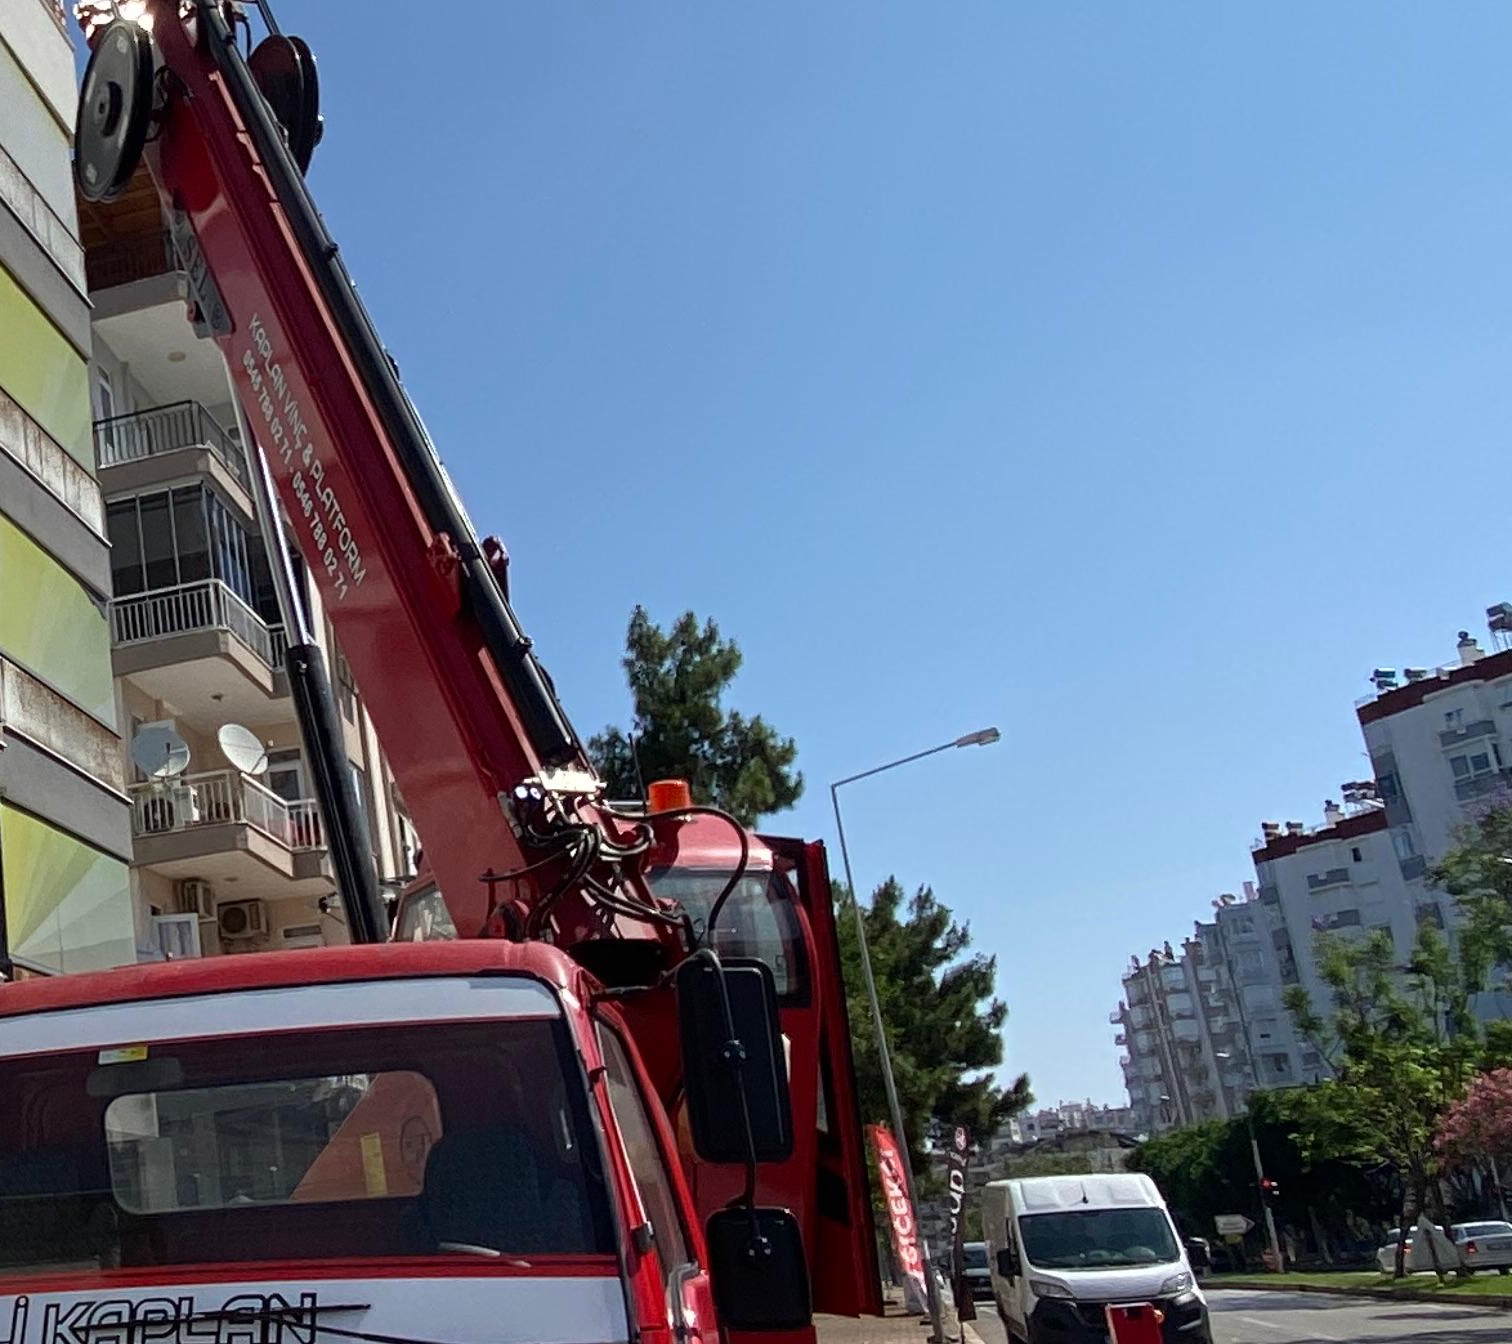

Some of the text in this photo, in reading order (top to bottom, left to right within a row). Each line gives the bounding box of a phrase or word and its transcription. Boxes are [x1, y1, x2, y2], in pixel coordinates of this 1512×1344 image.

[249, 311, 287, 401] KAPLAN
[302, 442, 314, 467] &
[309, 458, 367, 587] PLATFORM
[310, 511, 328, 552] 788
[323, 547, 338, 576] 02
[334, 571, 349, 601] 71
